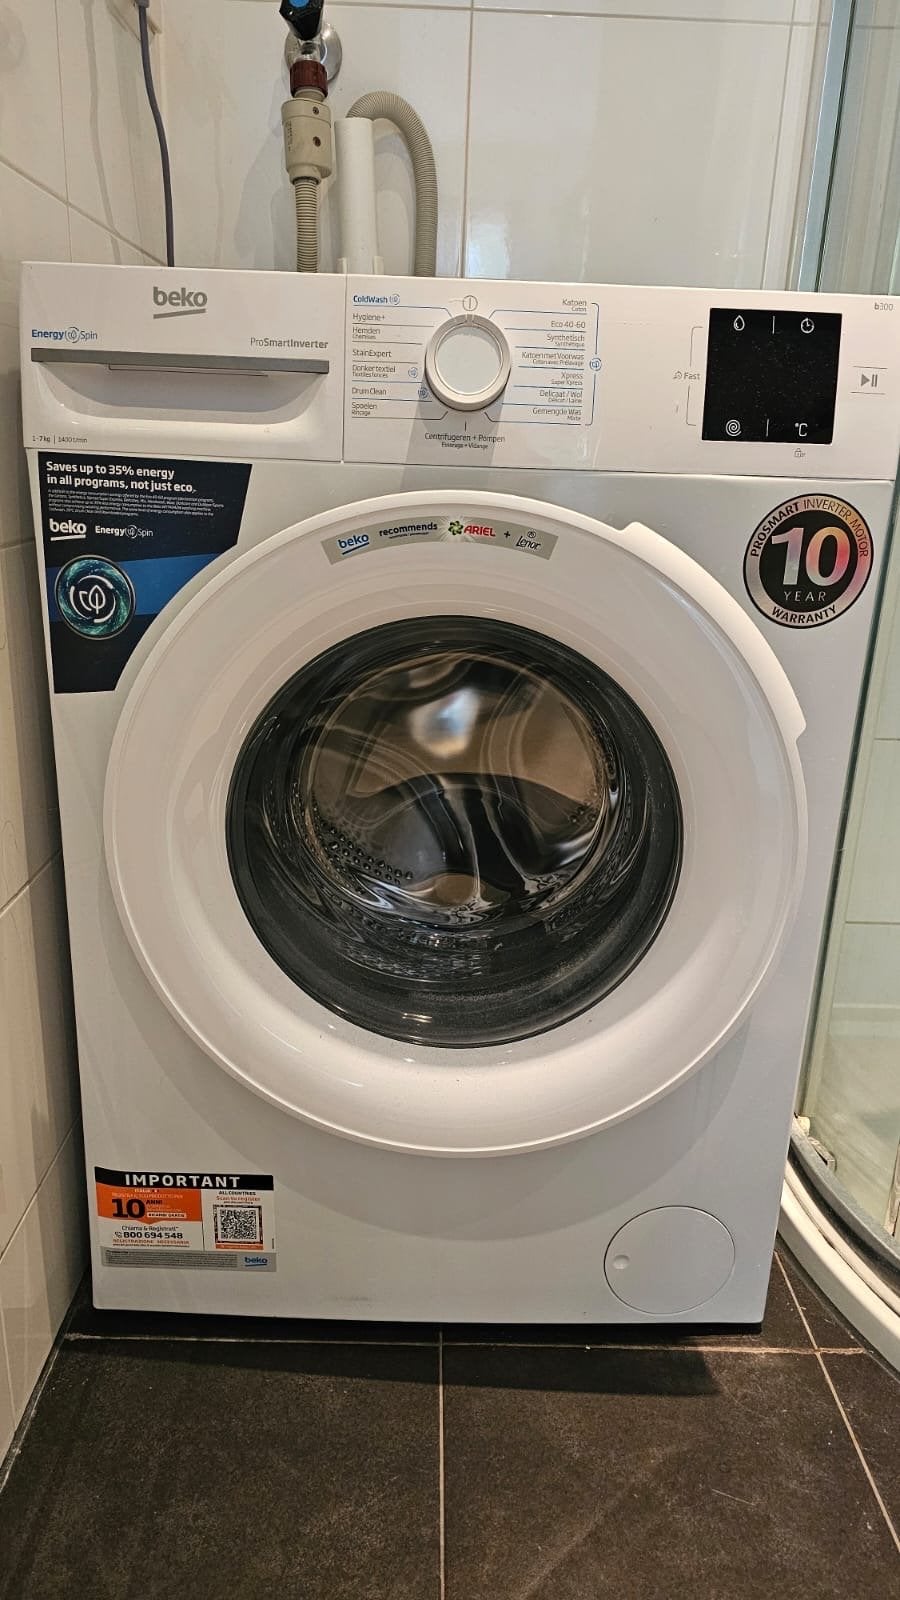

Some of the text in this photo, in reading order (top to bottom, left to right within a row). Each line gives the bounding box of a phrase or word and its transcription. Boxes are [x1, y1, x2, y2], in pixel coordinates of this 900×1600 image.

[153, 286, 208, 308] beko
[353, 295, 388, 304] ColdWash
[562, 299, 587, 307] Katoen
[874, 302, 894, 311] b300
[352, 313, 385, 322] Hygiene+
[551, 320, 563, 328] Eco
[31, 329, 98, 341] Energy Spin
[547, 333, 585, 342] Synthetisch
[250, 337, 329, 349] ProSmartInverter
[352, 349, 392, 358] StainExpert
[352, 364, 396, 373] Donker textiel
[561, 371, 583, 380] Xpress
[683, 372, 700, 380] Fast
[540, 389, 565, 398] Delicaat
[351, 402, 378, 410] Spoelen
[532, 407, 567, 416] Gemengde
[794, 422, 808, 437] °C
[424, 432, 471, 443] Centrifugeren
[478, 433, 506, 444] Pompen
[46, 460, 174, 481] Saves up to 35% energy
[46, 473, 58, 484] in
[59, 474, 72, 485] all
[74, 477, 129, 490] programs,
[130, 479, 149, 490] not
[149, 480, 172, 492] just
[49, 518, 87, 535] beko
[95, 525, 154, 538] Energy Spin
[378, 521, 438, 537] recommends
[463, 526, 496, 537] ARIEL
[749, 498, 870, 559] PROSMART INVERTER MOTOR
[503, 530, 512, 539] +
[337, 533, 370, 549] beko
[515, 535, 541, 550] Lenor
[771, 526, 851, 587] 10
[783, 590, 827, 602] YEAR
[771, 604, 836, 624] WARRANTY
[125, 1174, 240, 1188] IMPORTANT
[111, 1198, 146, 1219] 10
[123, 1231, 143, 1239] 800
[144, 1231, 163, 1239] 694
[244, 1256, 268, 1264] beko
